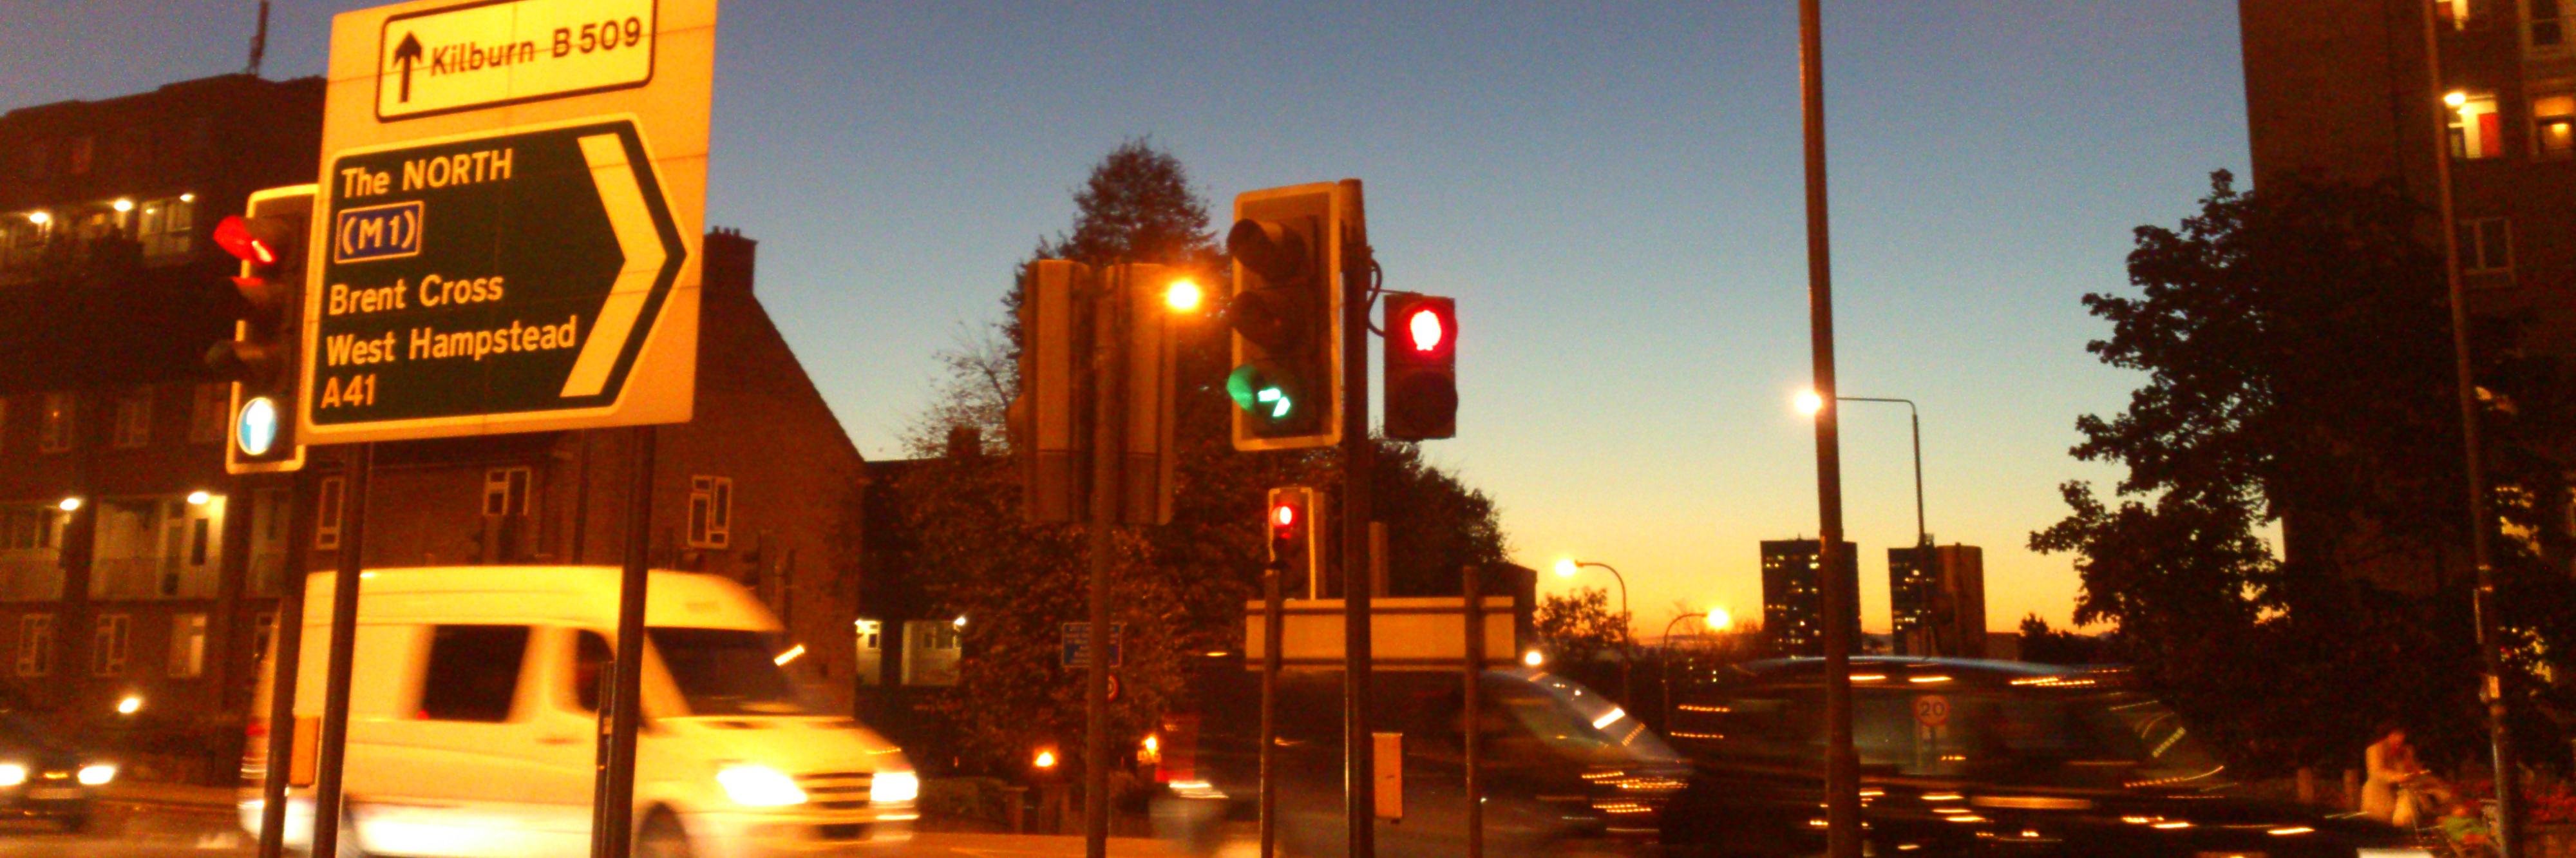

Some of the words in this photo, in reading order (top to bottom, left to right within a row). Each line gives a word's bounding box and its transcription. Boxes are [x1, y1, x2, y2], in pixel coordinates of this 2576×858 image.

[430, 41, 535, 76] Kilburn
[341, 167, 391, 198] The
[402, 148, 513, 191] NORTH
[342, 209, 416, 255] (M1)
[328, 278, 408, 316] Brent
[419, 274, 504, 307] Cross
[327, 330, 397, 367] West
[409, 314, 578, 361] Hampstead
[321, 373, 376, 408] A41
[1920, 701, 1944, 716] 20
